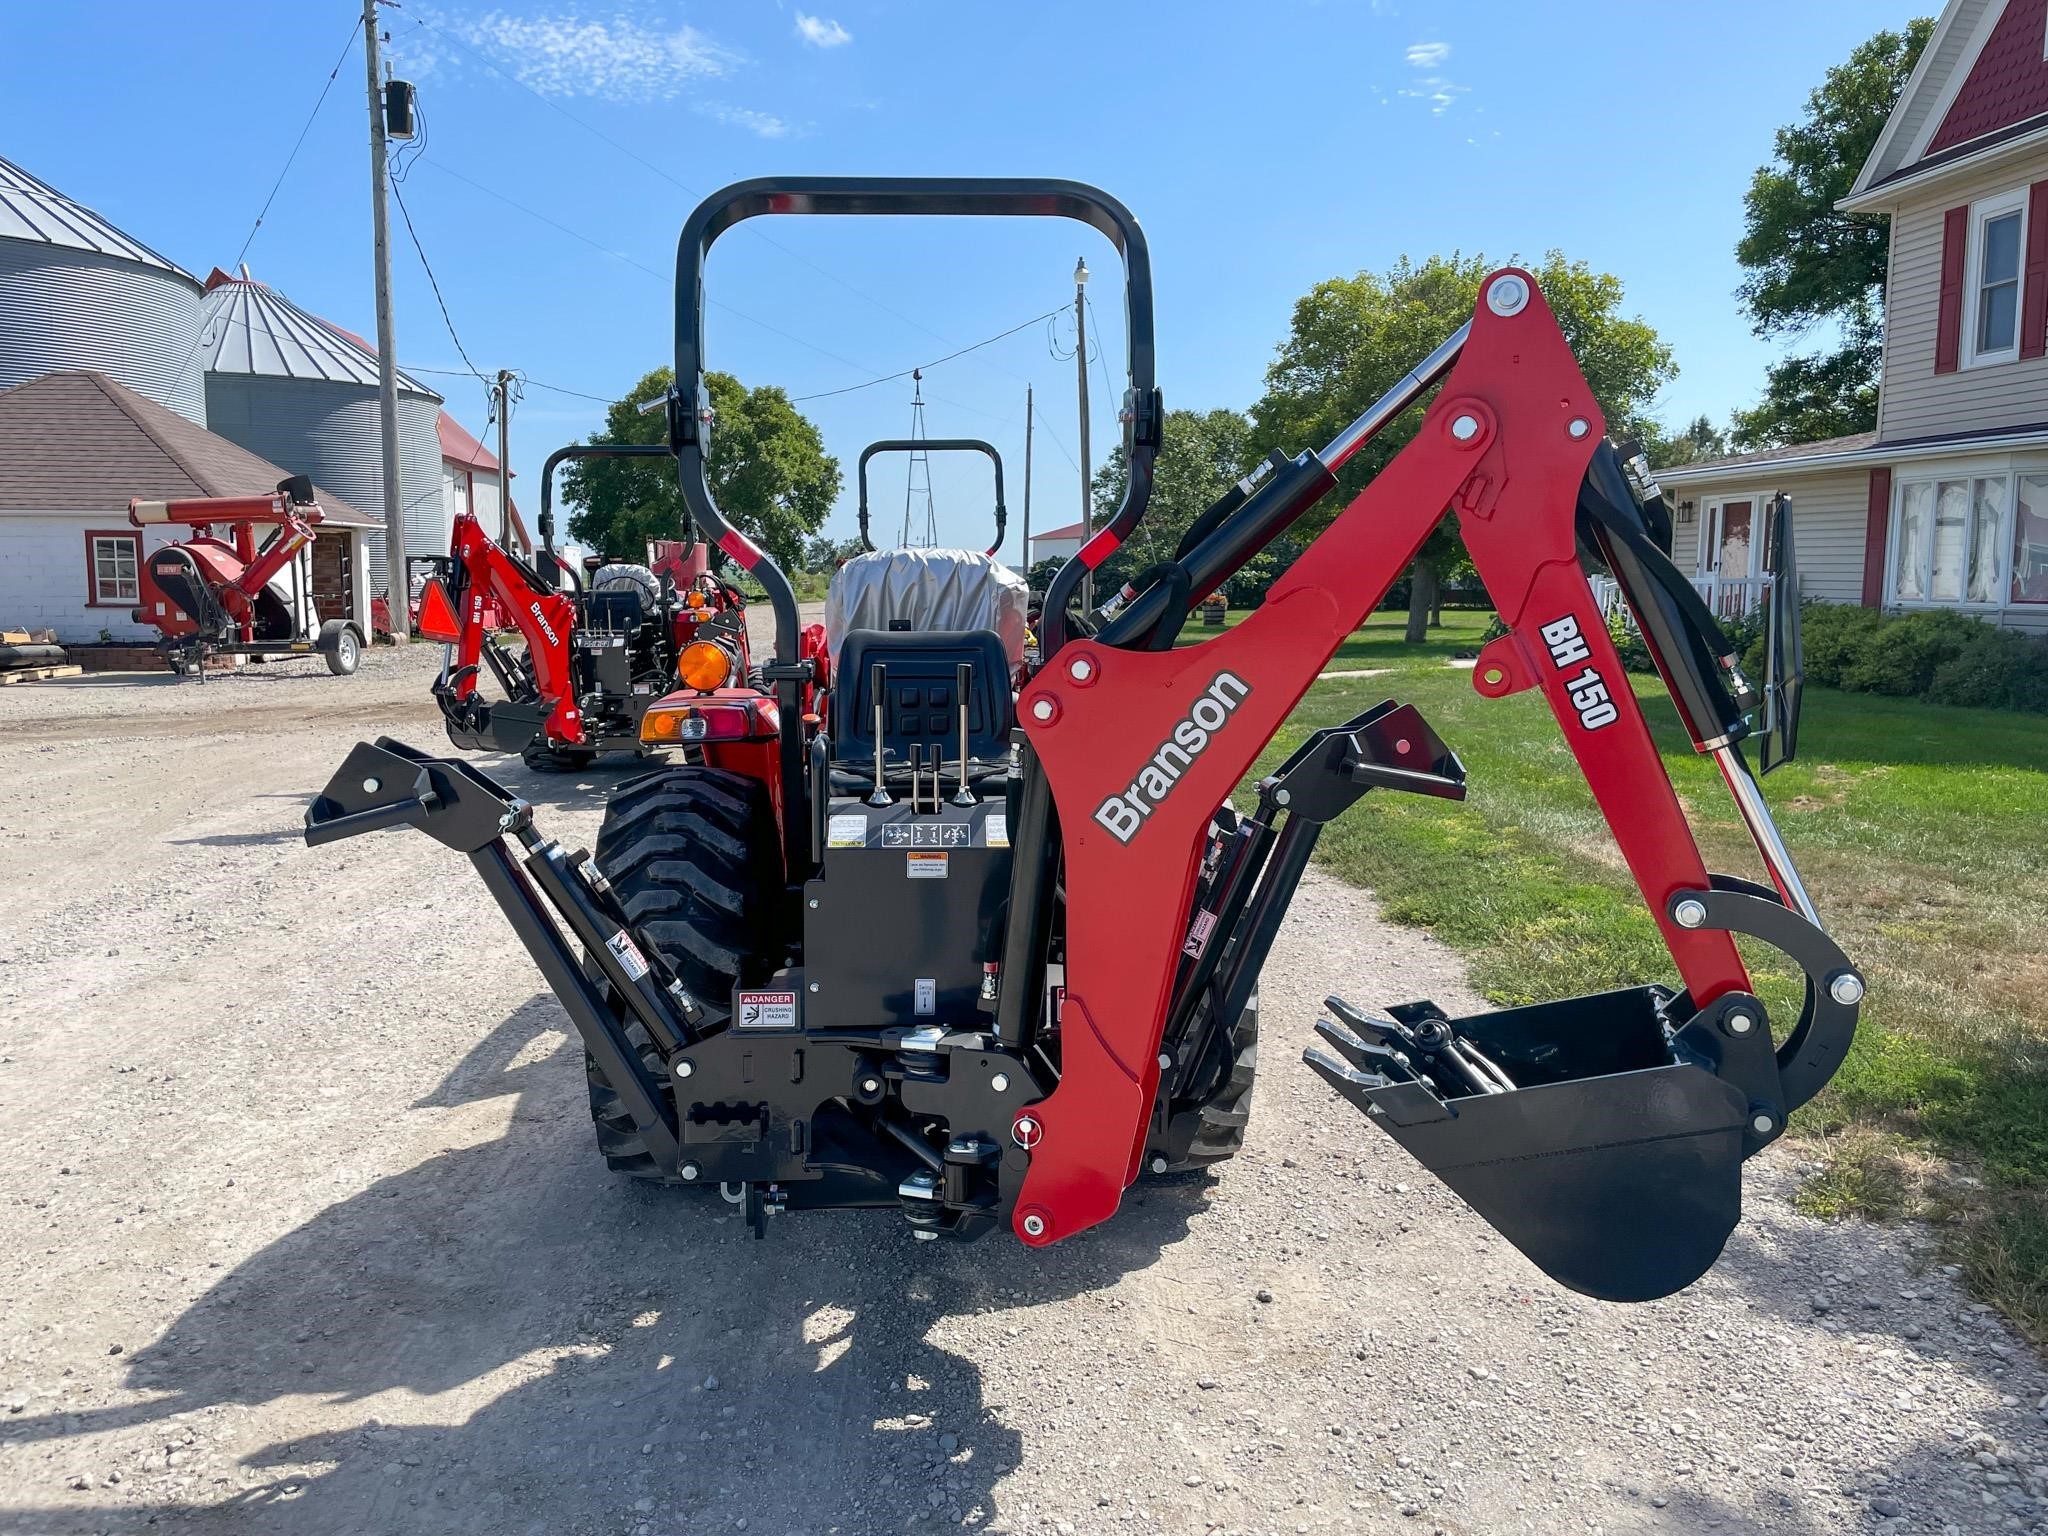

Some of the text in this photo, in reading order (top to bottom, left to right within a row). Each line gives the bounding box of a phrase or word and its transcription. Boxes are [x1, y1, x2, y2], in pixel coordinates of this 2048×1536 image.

[472, 595, 483, 624] BH 150
[530, 601, 560, 647] Branson
[1539, 613, 1619, 731] BH 150
[1093, 671, 1251, 844] Branson
[751, 995, 790, 1003] DANGER
